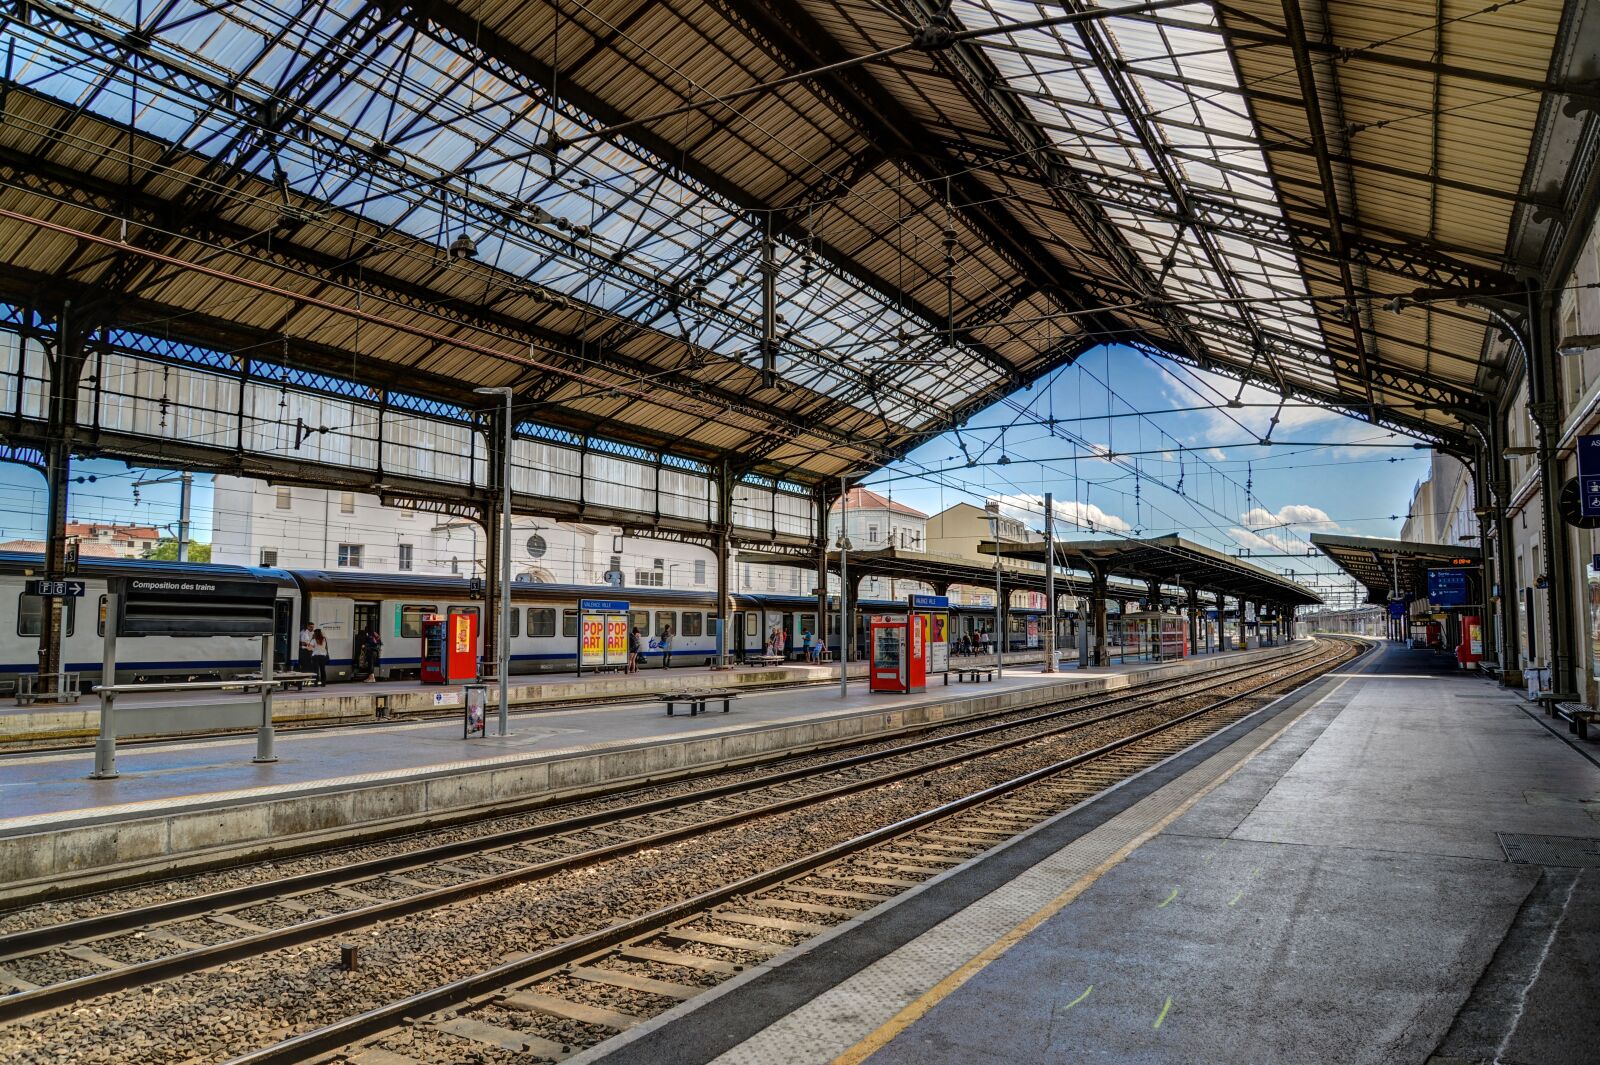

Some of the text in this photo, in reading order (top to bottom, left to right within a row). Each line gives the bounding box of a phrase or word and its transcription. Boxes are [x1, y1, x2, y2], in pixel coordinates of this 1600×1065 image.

[56, 586, 63, 594] G
[132, 580, 216, 591] Composition des trains
[583, 622, 603, 635] POP
[608, 622, 627, 635] POP
[583, 637, 601, 649] ART
[608, 637, 625, 649] ART
